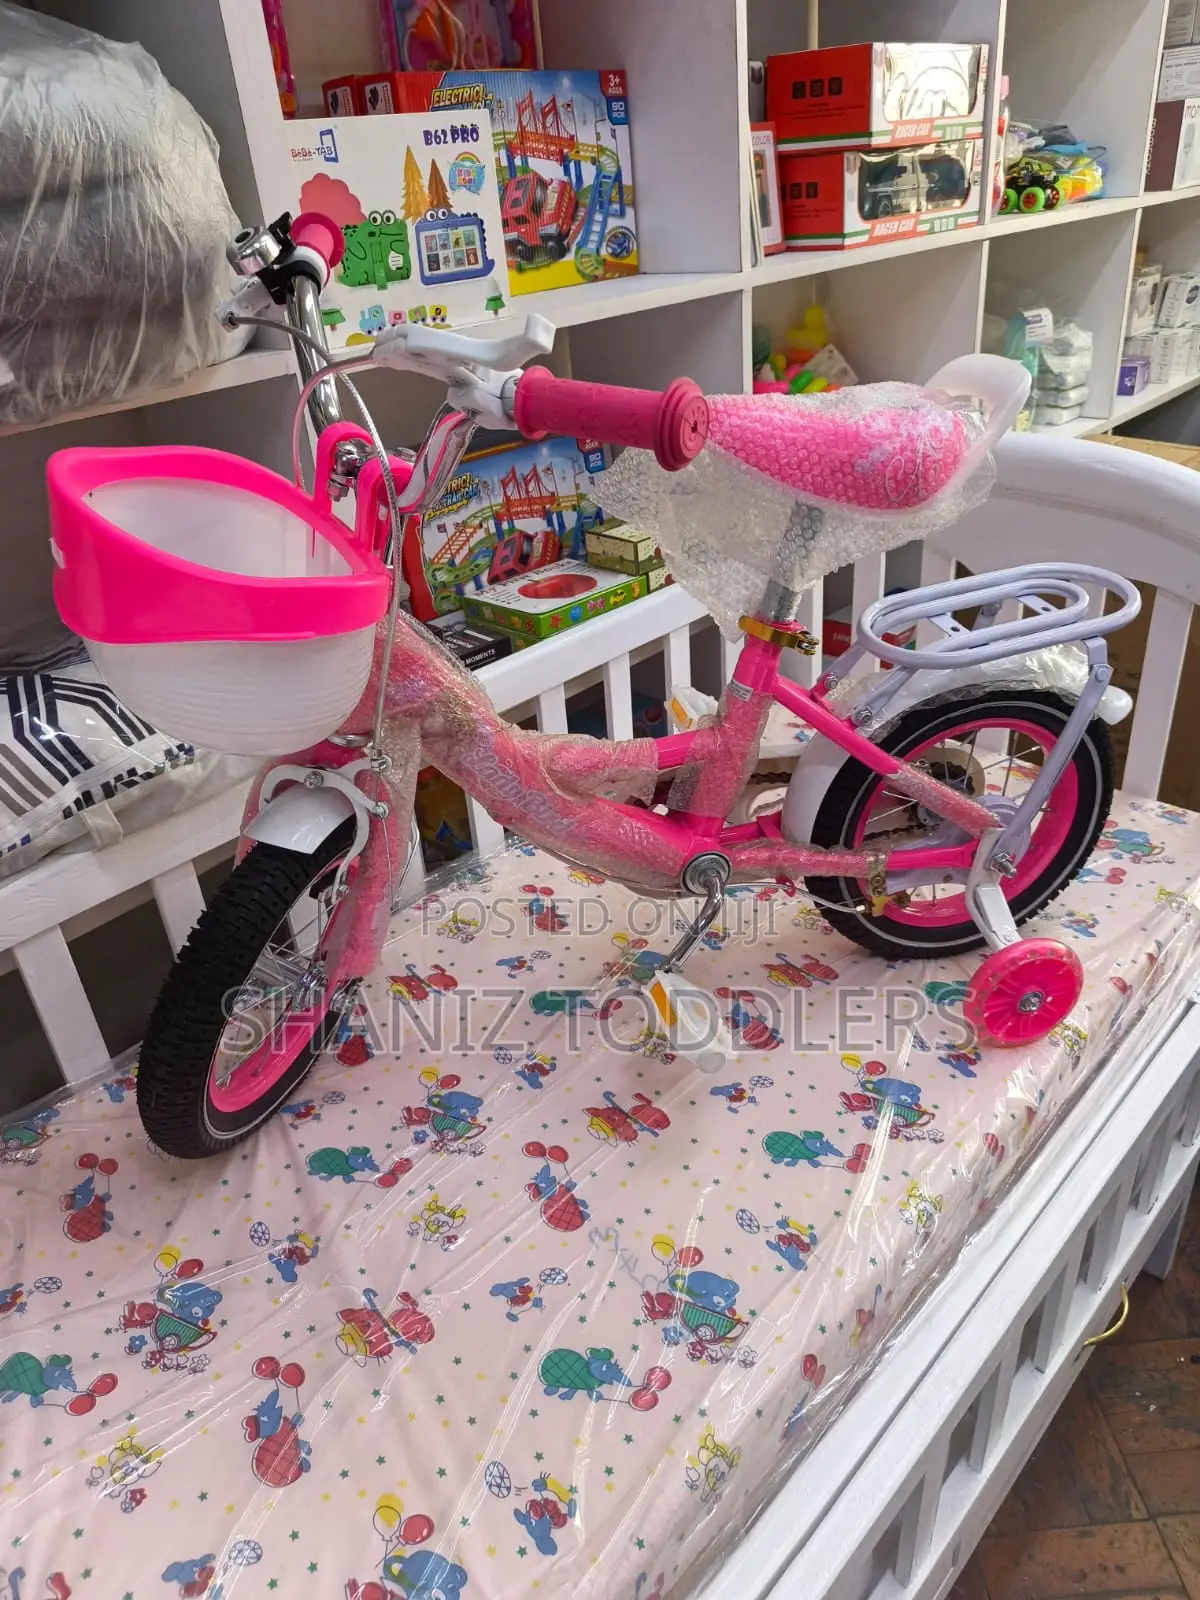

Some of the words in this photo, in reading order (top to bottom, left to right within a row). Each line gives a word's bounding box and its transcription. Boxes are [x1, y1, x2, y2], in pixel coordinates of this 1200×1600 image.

[608, 74, 620, 87] 3+
[611, 101, 625, 111] 90
[423, 130, 448, 146] B62
[450, 124, 480, 144] PRO
[466, 648, 496, 665] MOMENTS
